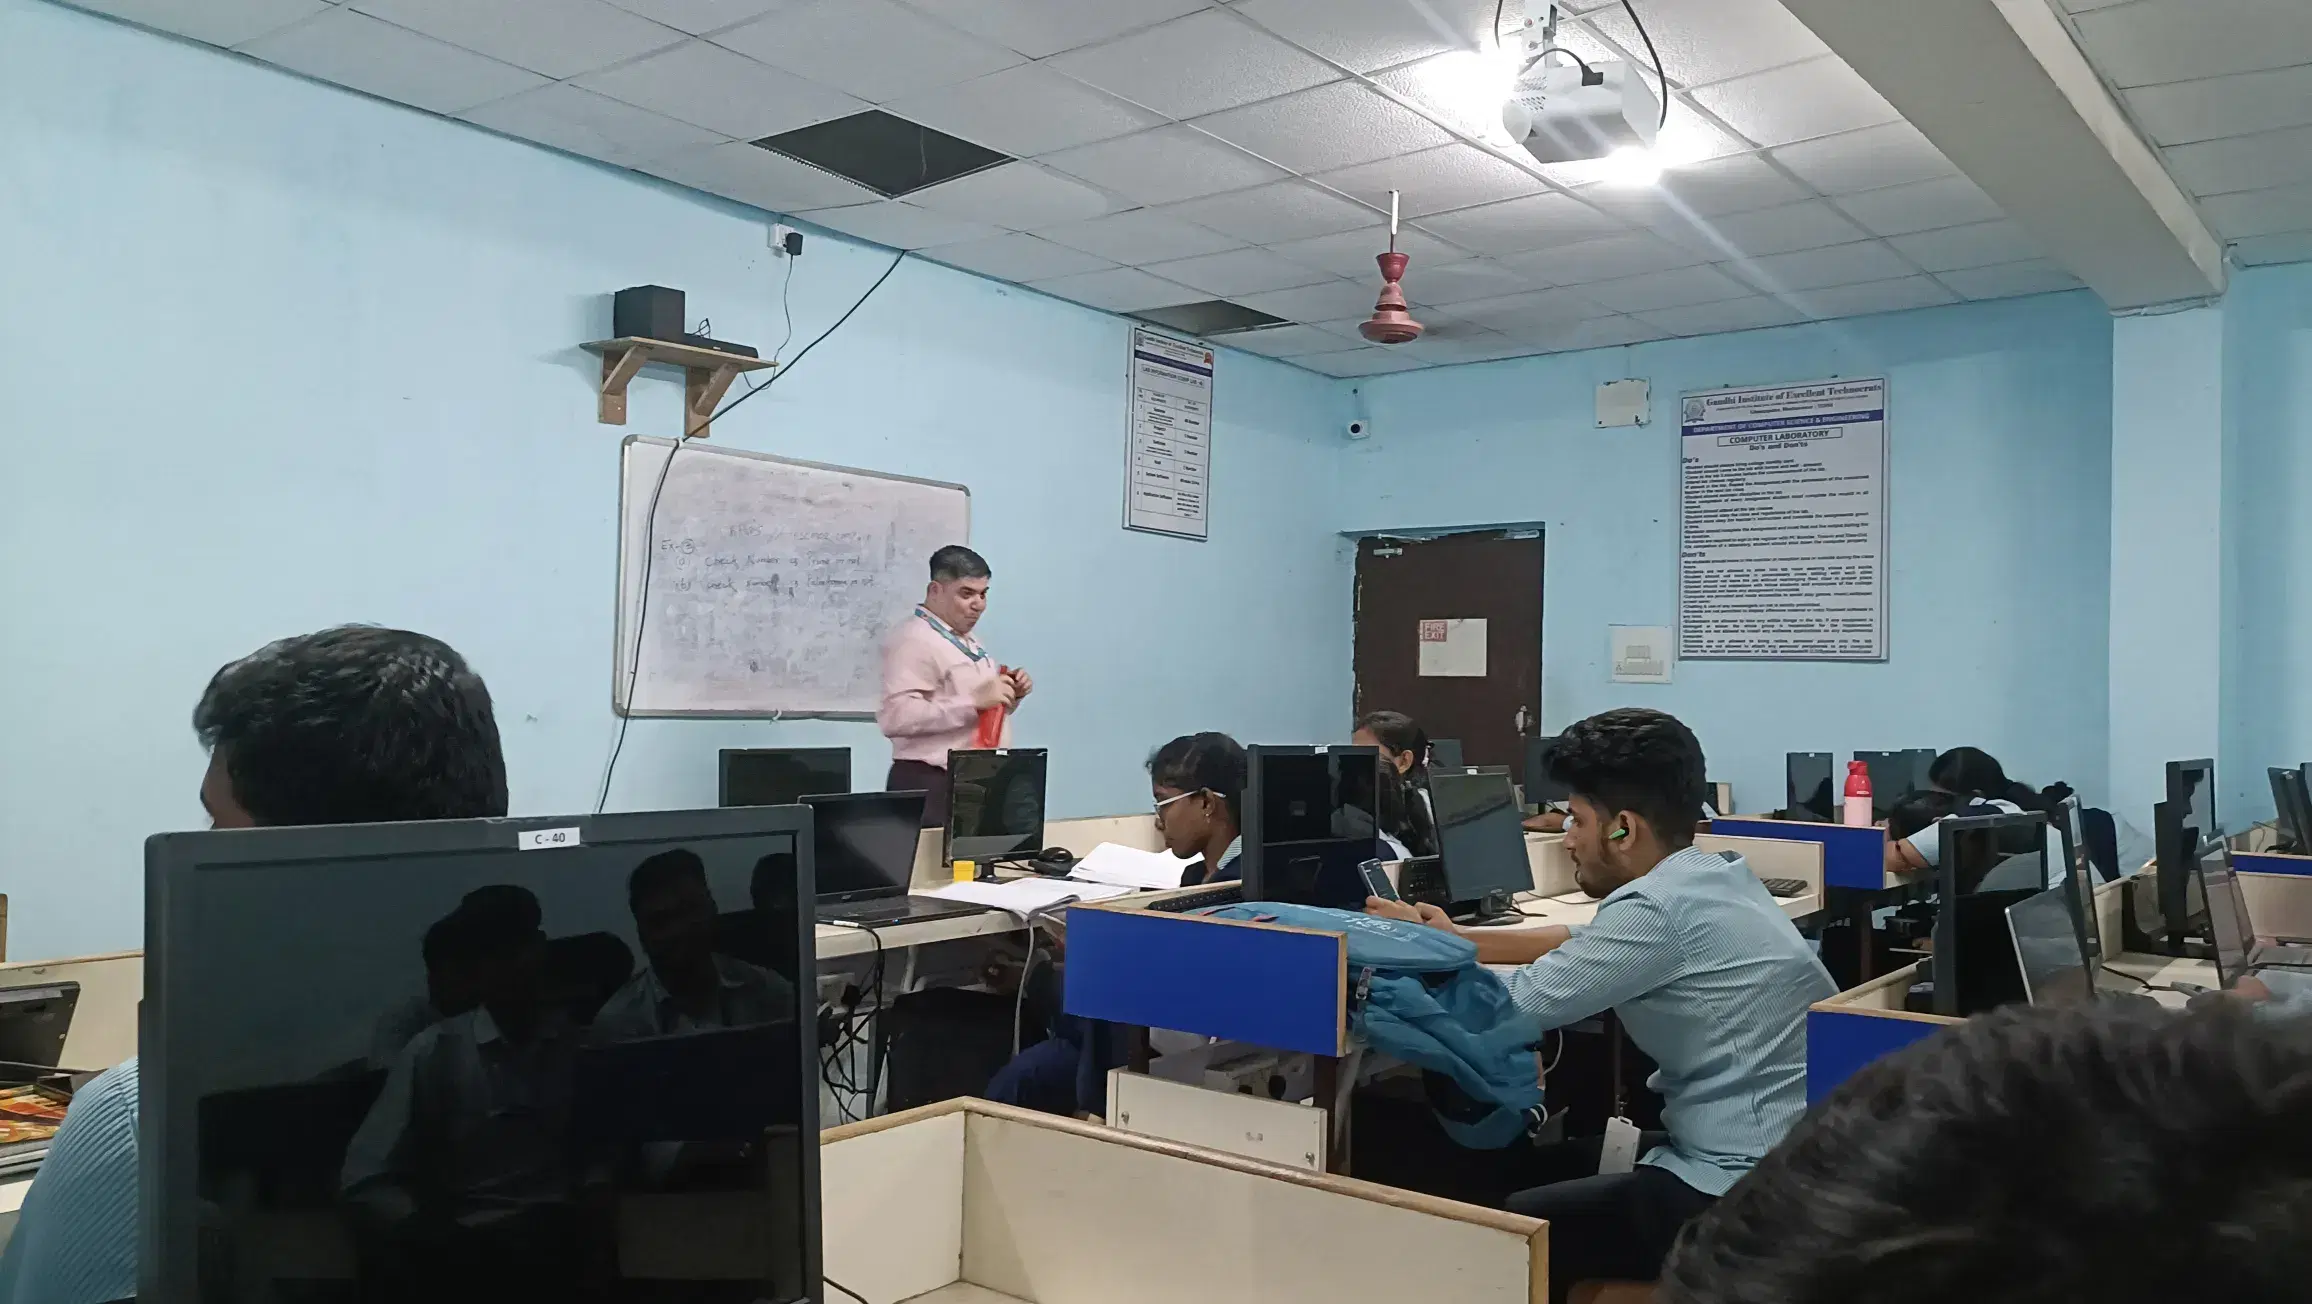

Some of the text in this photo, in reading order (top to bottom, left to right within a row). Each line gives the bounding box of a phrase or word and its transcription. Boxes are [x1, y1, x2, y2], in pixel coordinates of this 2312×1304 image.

[1738, 394, 1774, 404] Institute
[1775, 392, 1785, 400] of
[1827, 385, 1881, 396] Technocrats
[1693, 424, 1737, 433] DEPARTMENT
[1748, 420, 1785, 429] COMPUTER
[1786, 418, 1814, 426] SCIENCE
[1822, 413, 1870, 423] ENGINEERING
[1729, 430, 1829, 444] COMPUTER LABORATORY
[1424, 622, 1445, 632] FIRE
[1424, 631, 1445, 640] EXIT
[552, 832, 566, 843] 40
